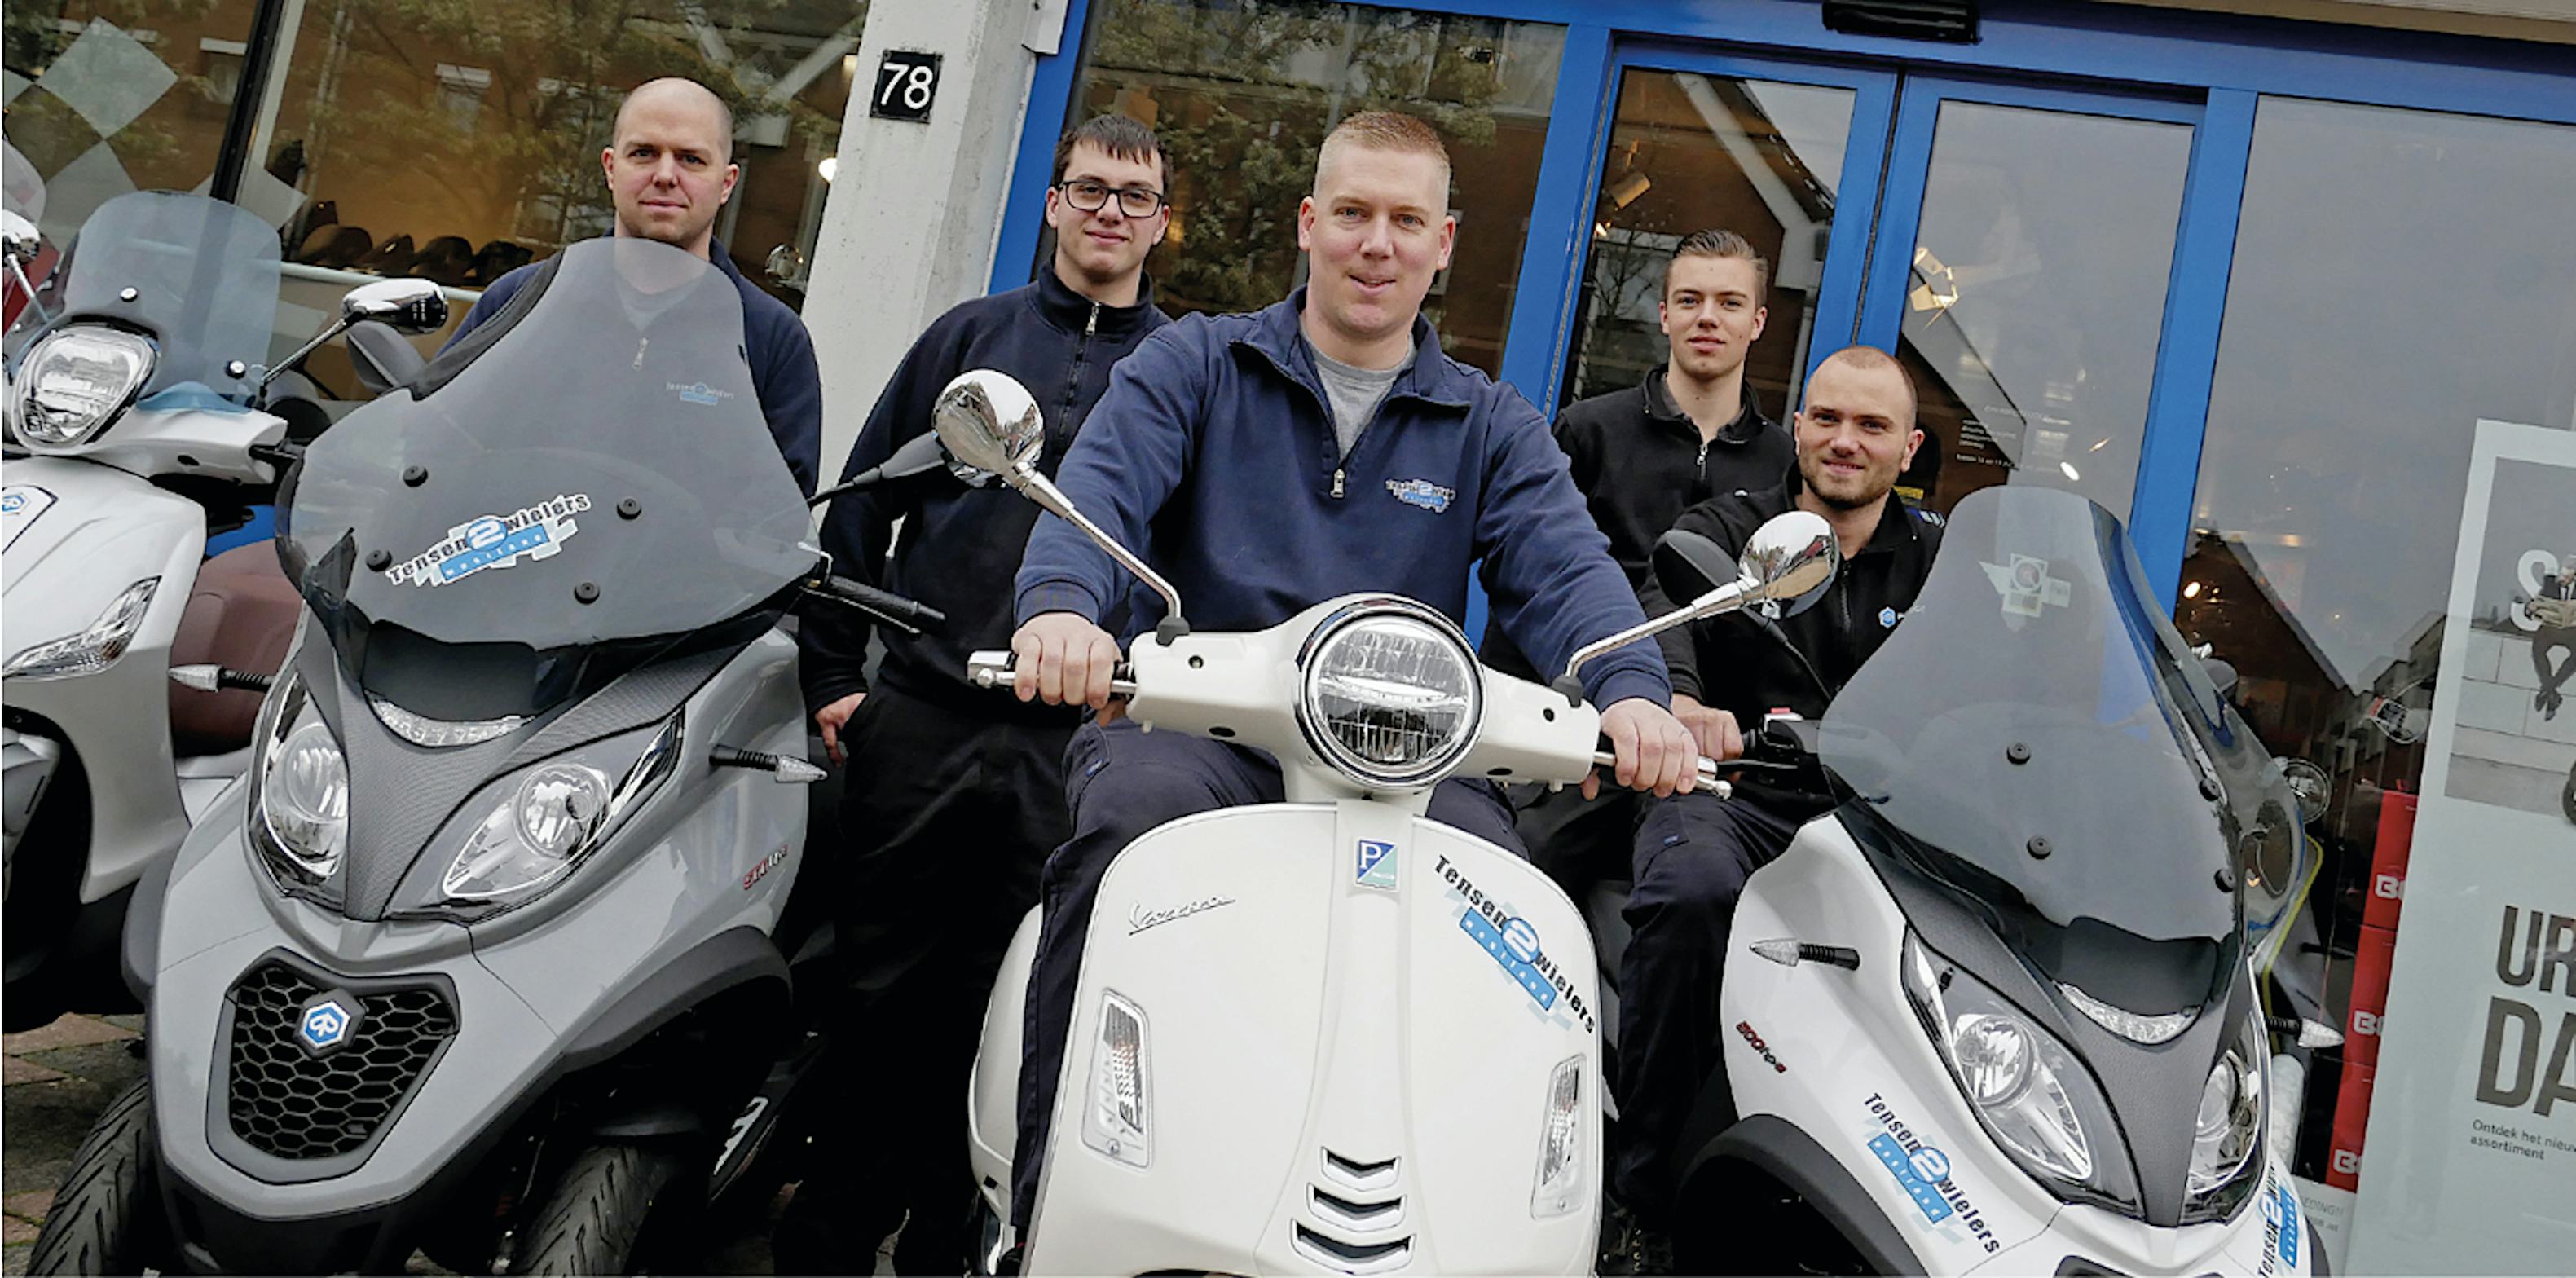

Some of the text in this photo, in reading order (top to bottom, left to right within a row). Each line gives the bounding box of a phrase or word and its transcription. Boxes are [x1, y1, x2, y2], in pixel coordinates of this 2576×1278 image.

[880, 62, 933, 109] 78
[1359, 840, 1382, 870] P
[2473, 1118, 2517, 1139] Ontdek
[2521, 1129, 2542, 1145] het
[2470, 1136, 2545, 1160] assortiment
